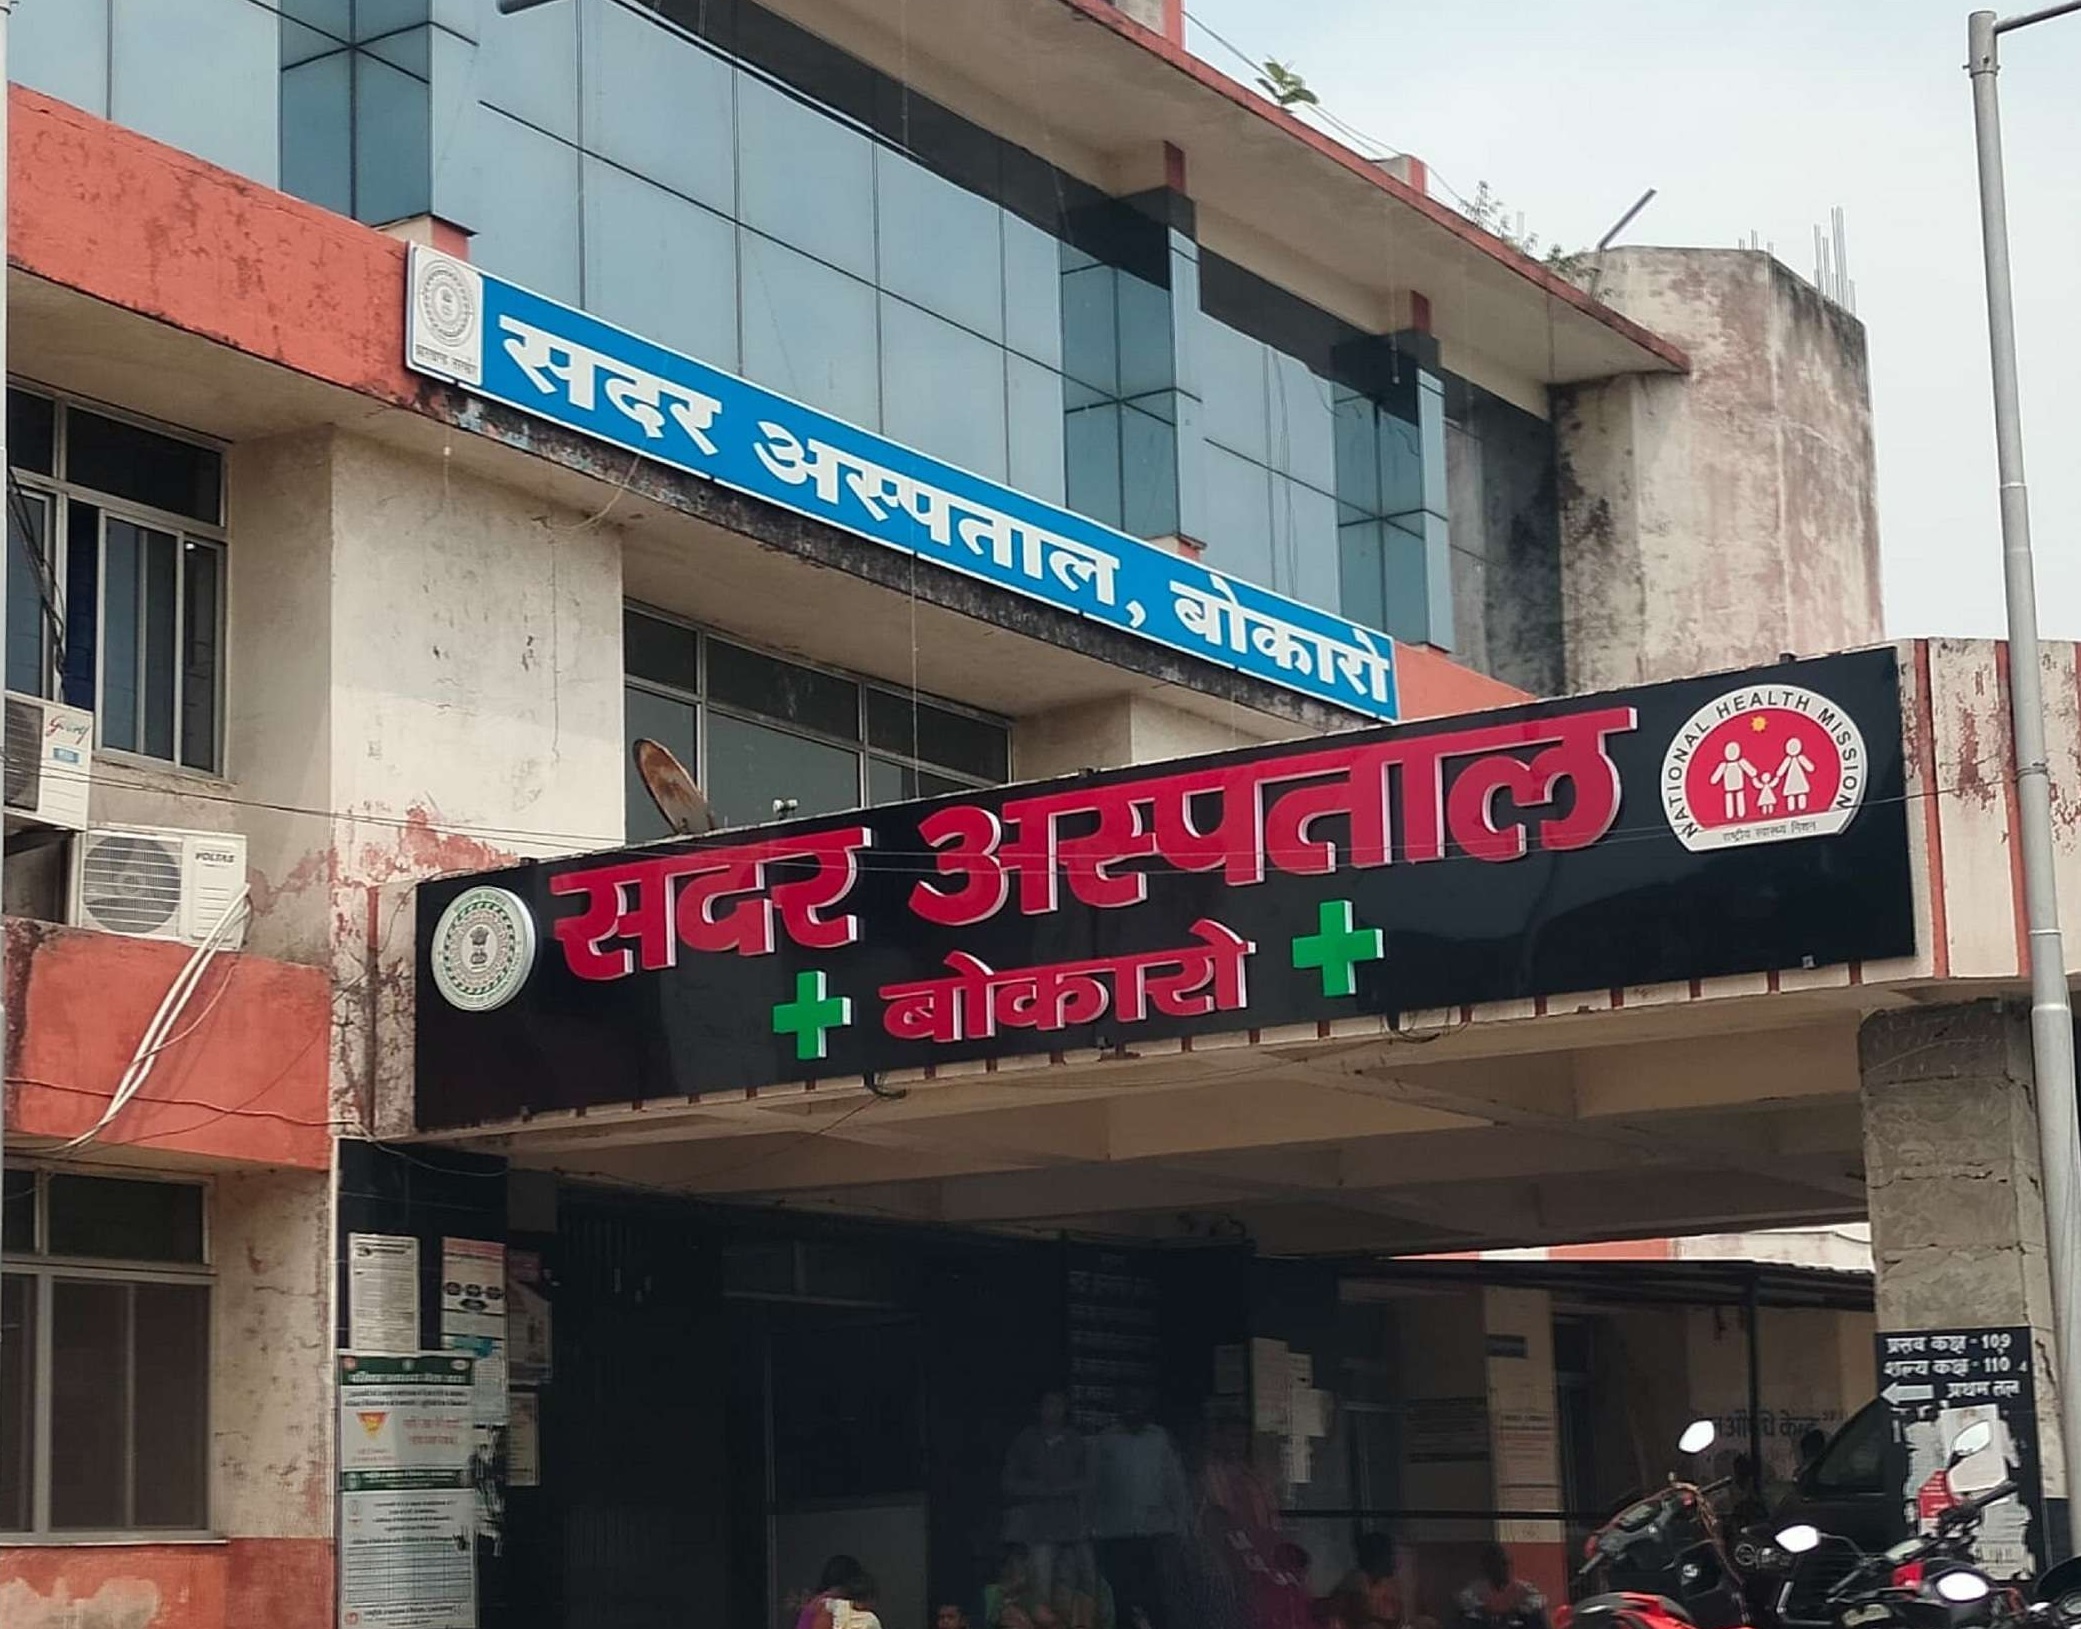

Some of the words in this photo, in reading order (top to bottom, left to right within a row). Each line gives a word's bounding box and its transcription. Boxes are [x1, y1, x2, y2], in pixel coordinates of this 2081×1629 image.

[499, 314, 723, 457] सदर
[1168, 574, 1390, 703] बोकारो
[1667, 721, 1711, 839] NATIONAL
[1715, 690, 1811, 719] HEALTH
[1816, 707, 1859, 811] MISSION
[550, 826, 872, 981] सदर
[909, 706, 1638, 926] अस्पताल
[878, 918, 1256, 1044] बोकारो
[1980, 1333, 2012, 1350] 109
[1983, 1356, 2011, 1373] 110
